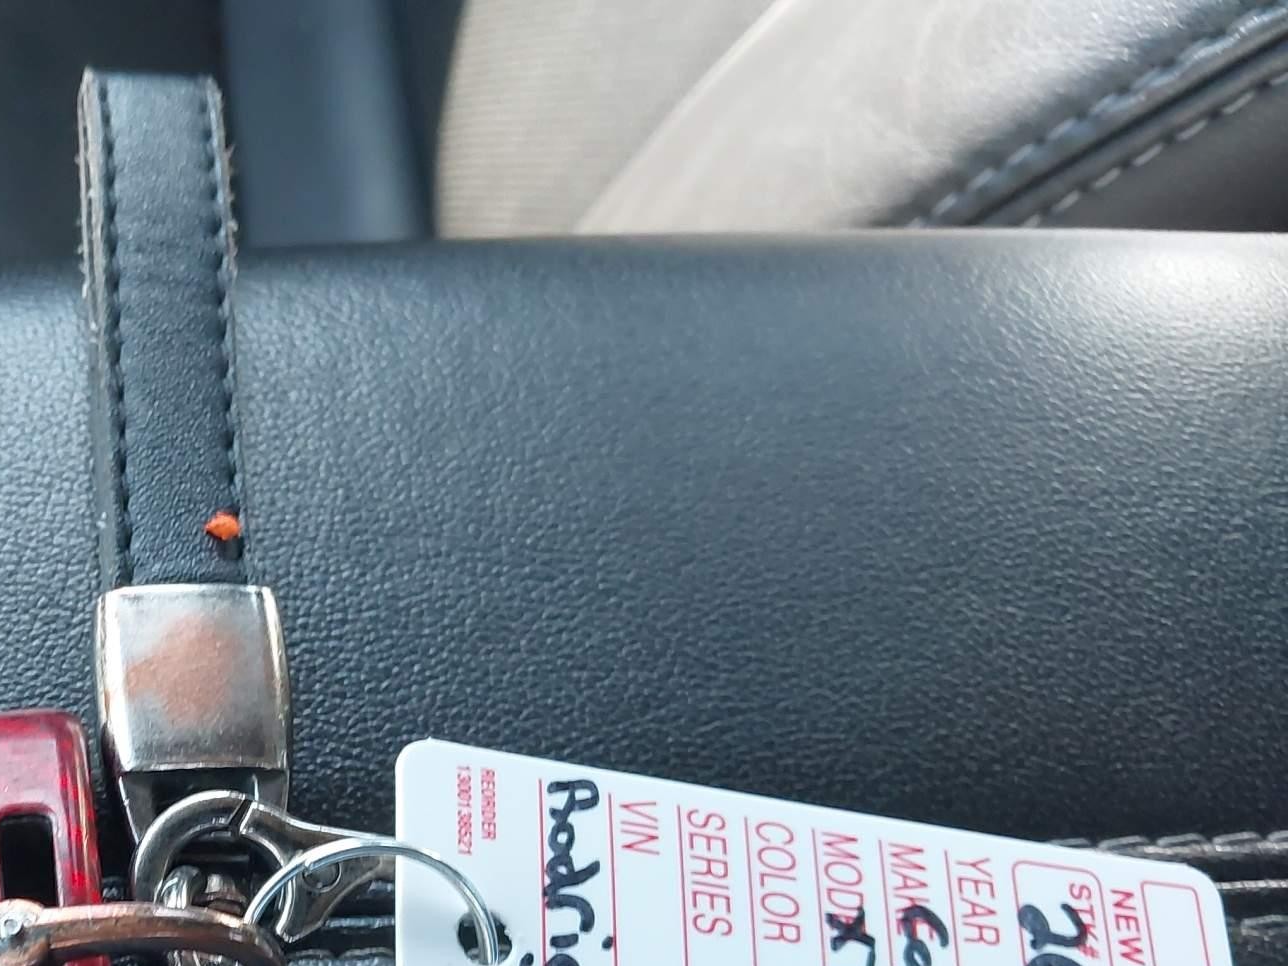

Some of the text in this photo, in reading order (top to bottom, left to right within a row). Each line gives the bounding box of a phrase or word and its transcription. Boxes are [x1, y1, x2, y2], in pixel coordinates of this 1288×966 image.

[481, 768, 496, 840] REORDER
[620, 801, 660, 855] VIN
[688, 808, 732, 936] SERIES
[756, 821, 800, 944] COLOR
[820, 832, 864, 940] MOD
[888, 842, 936, 940] MAKE
[956, 857, 1000, 946] YEAR
[1110, 889, 1144, 966] NEW
